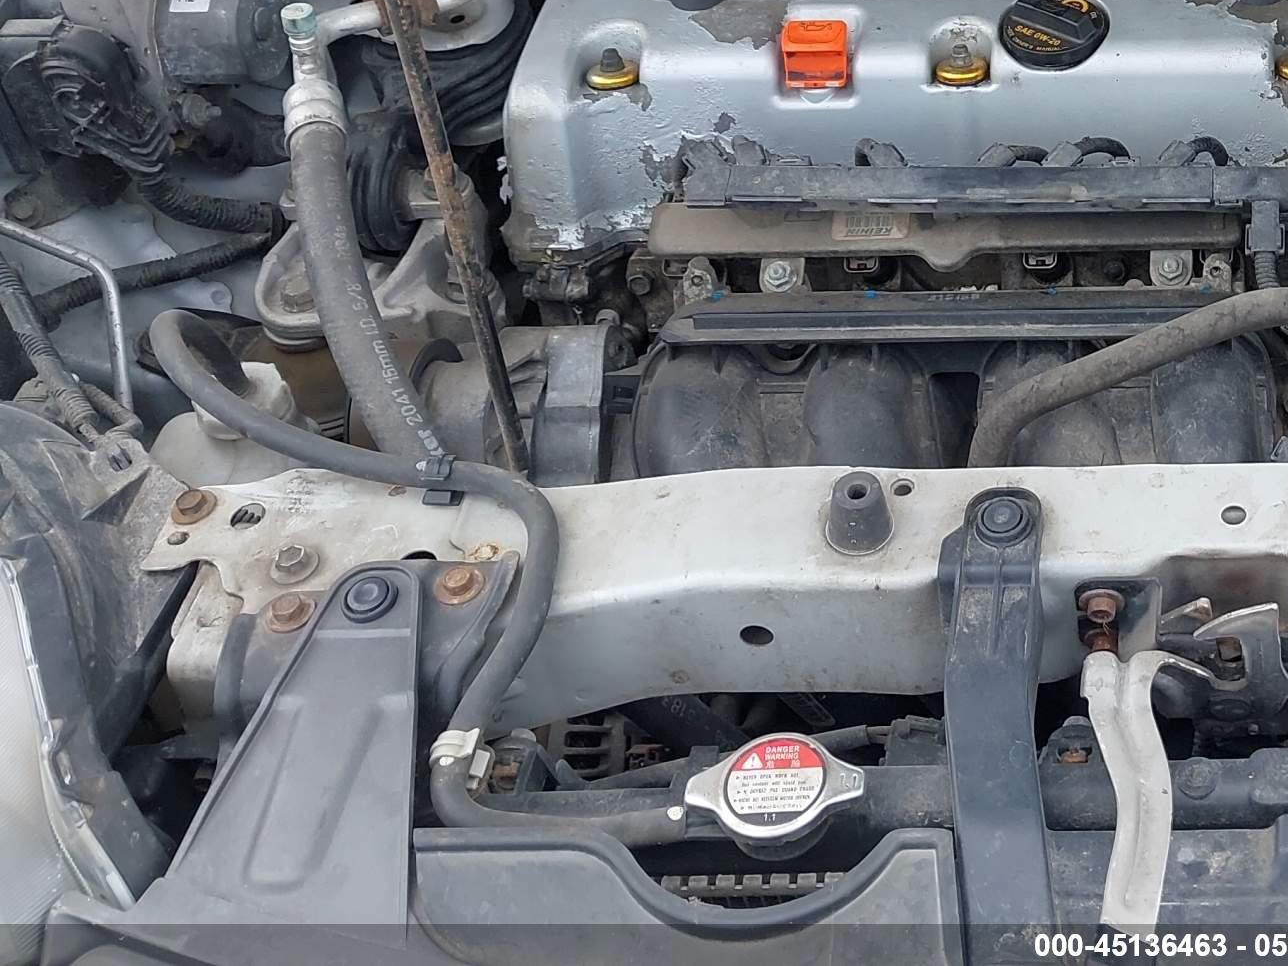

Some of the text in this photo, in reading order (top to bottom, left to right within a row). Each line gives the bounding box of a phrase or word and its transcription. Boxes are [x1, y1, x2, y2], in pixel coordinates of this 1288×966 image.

[1014, 25, 1034, 37] SAE
[1034, 32, 1061, 47] 0W-20
[847, 225, 894, 235] KEIHIN
[765, 745, 801, 754] DANGER
[764, 753, 799, 761] WARNING
[763, 813, 777, 822] 1.1
